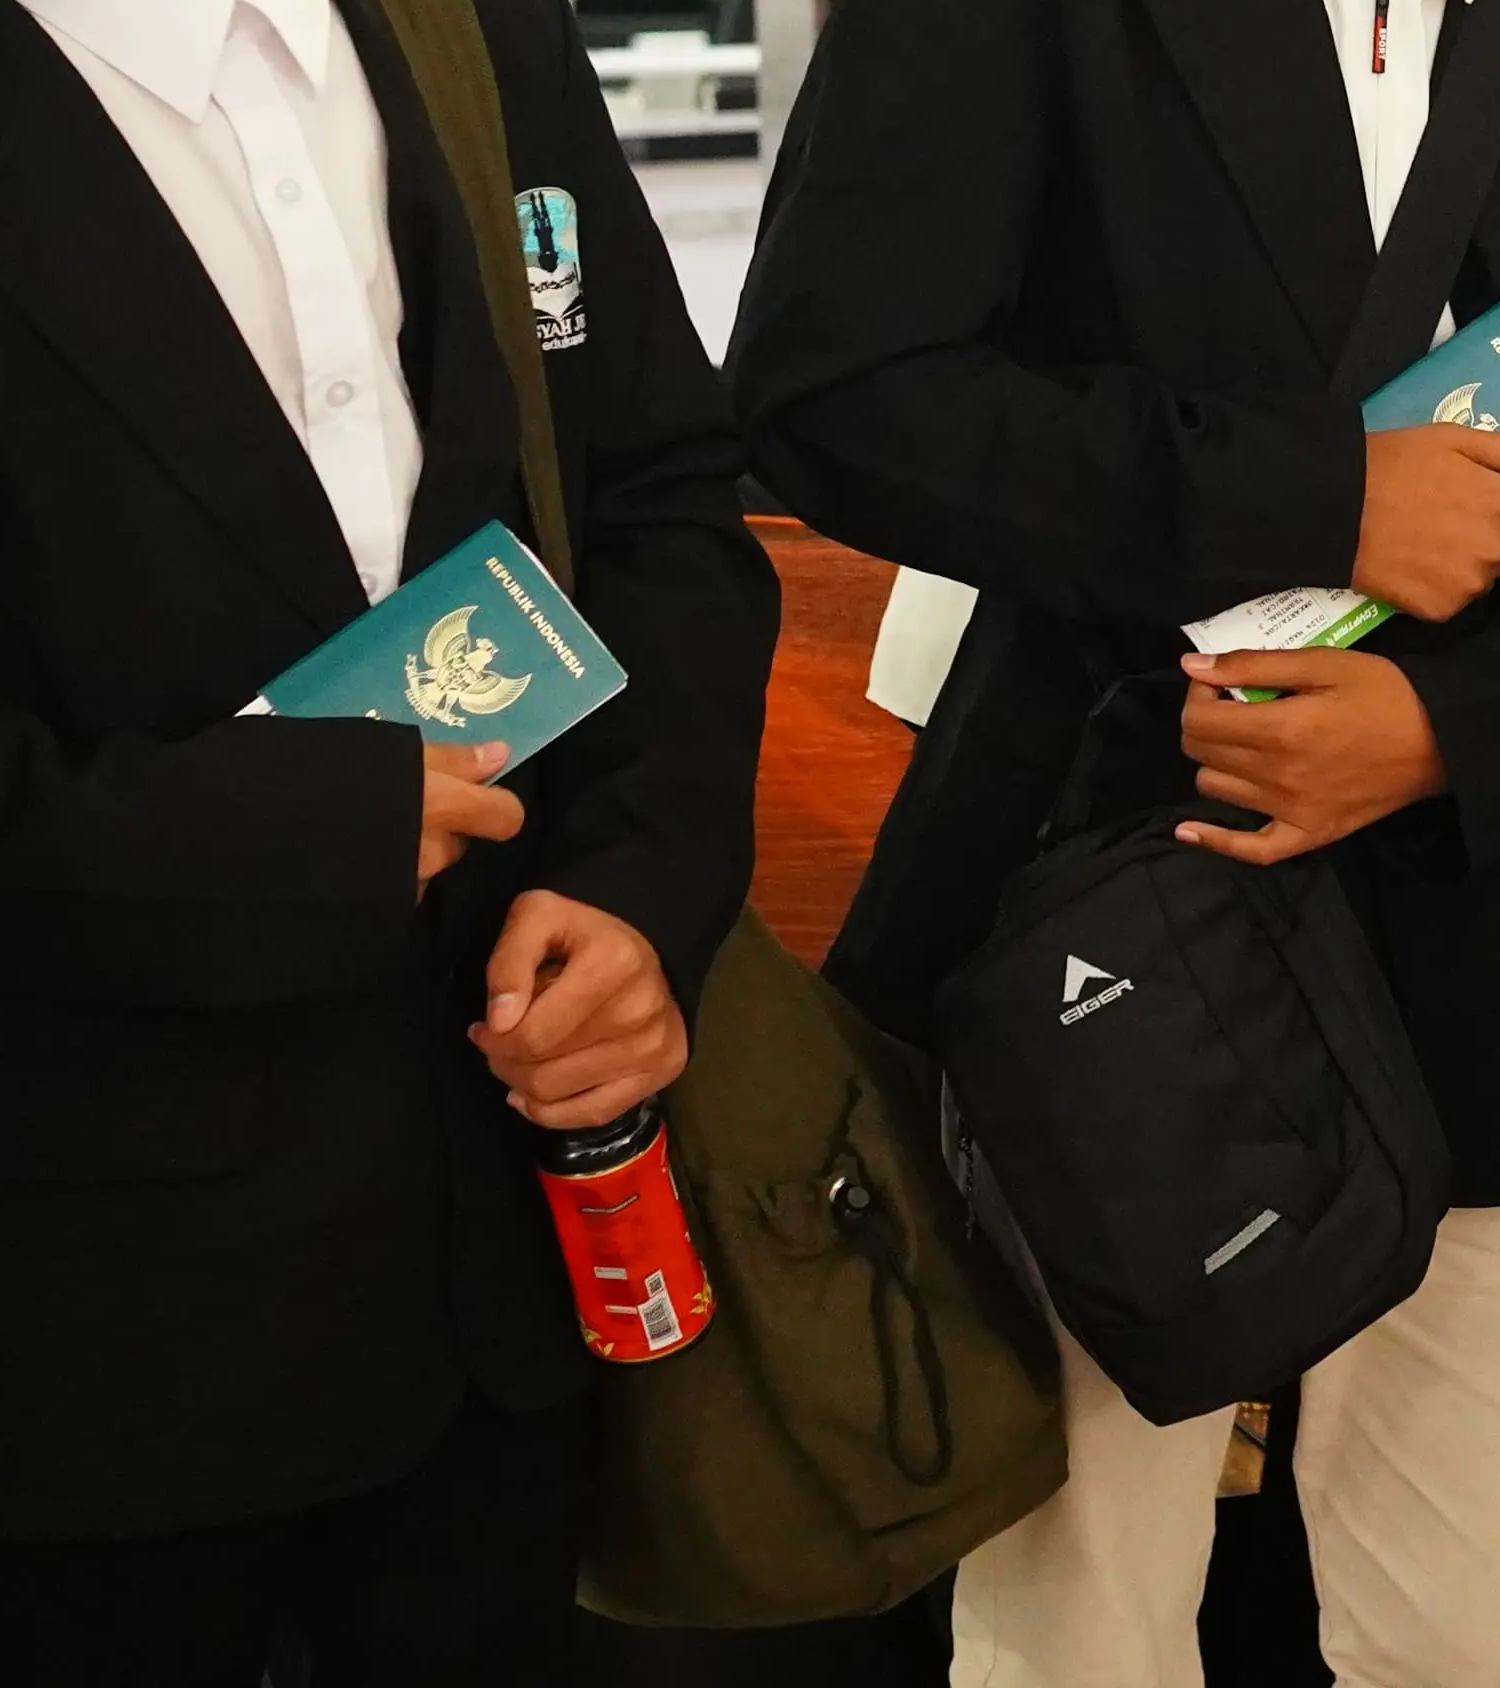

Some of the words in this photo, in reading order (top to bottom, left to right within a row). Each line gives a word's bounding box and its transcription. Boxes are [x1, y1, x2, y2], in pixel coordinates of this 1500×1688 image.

[485, 556, 535, 615] REPUBLIK
[530, 611, 586, 680] INDONESIA
[1059, 978, 1135, 1026] EIGER
